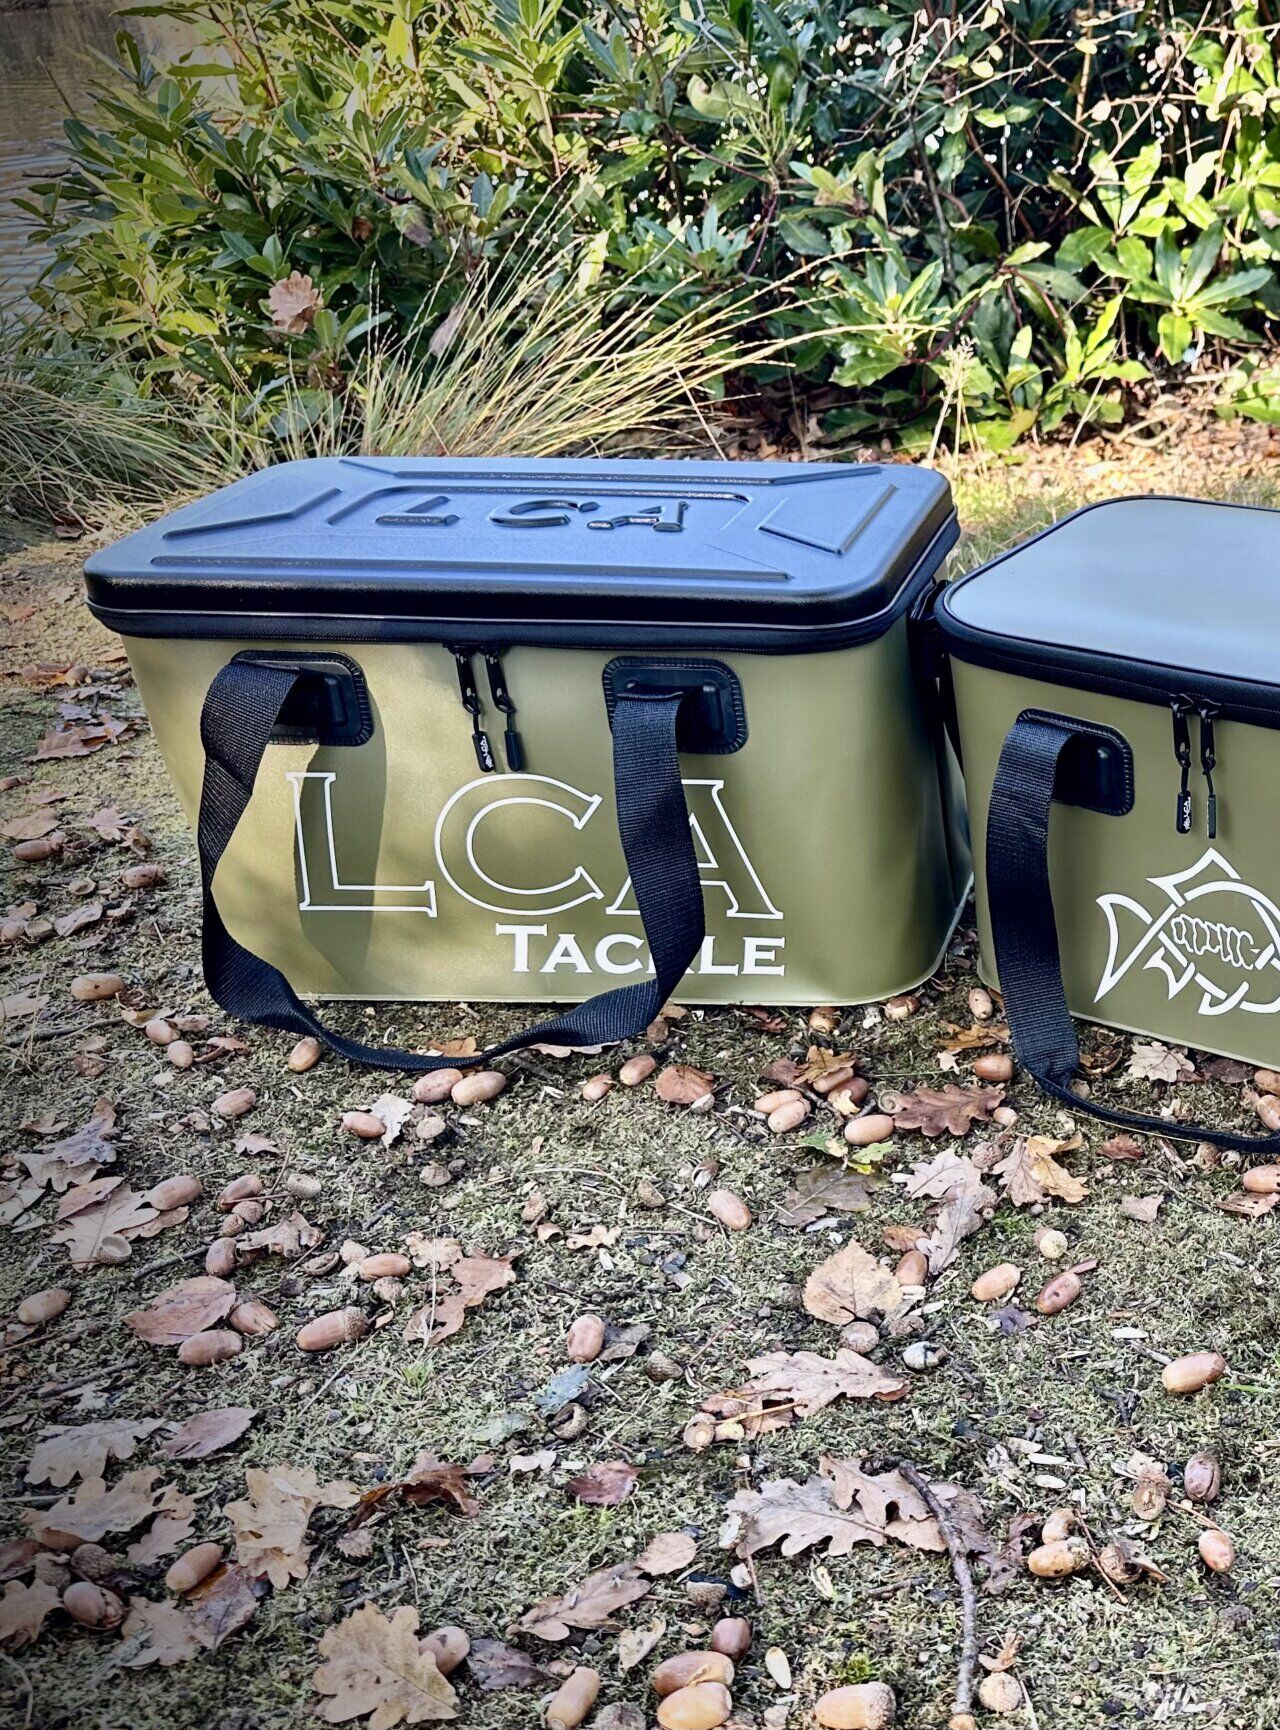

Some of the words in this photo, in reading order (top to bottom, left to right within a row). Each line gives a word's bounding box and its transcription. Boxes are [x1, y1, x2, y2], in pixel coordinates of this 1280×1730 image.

[375, 496, 690, 532] LCA
[286, 772, 784, 919] LCA
[495, 923, 786, 977] TACLE
